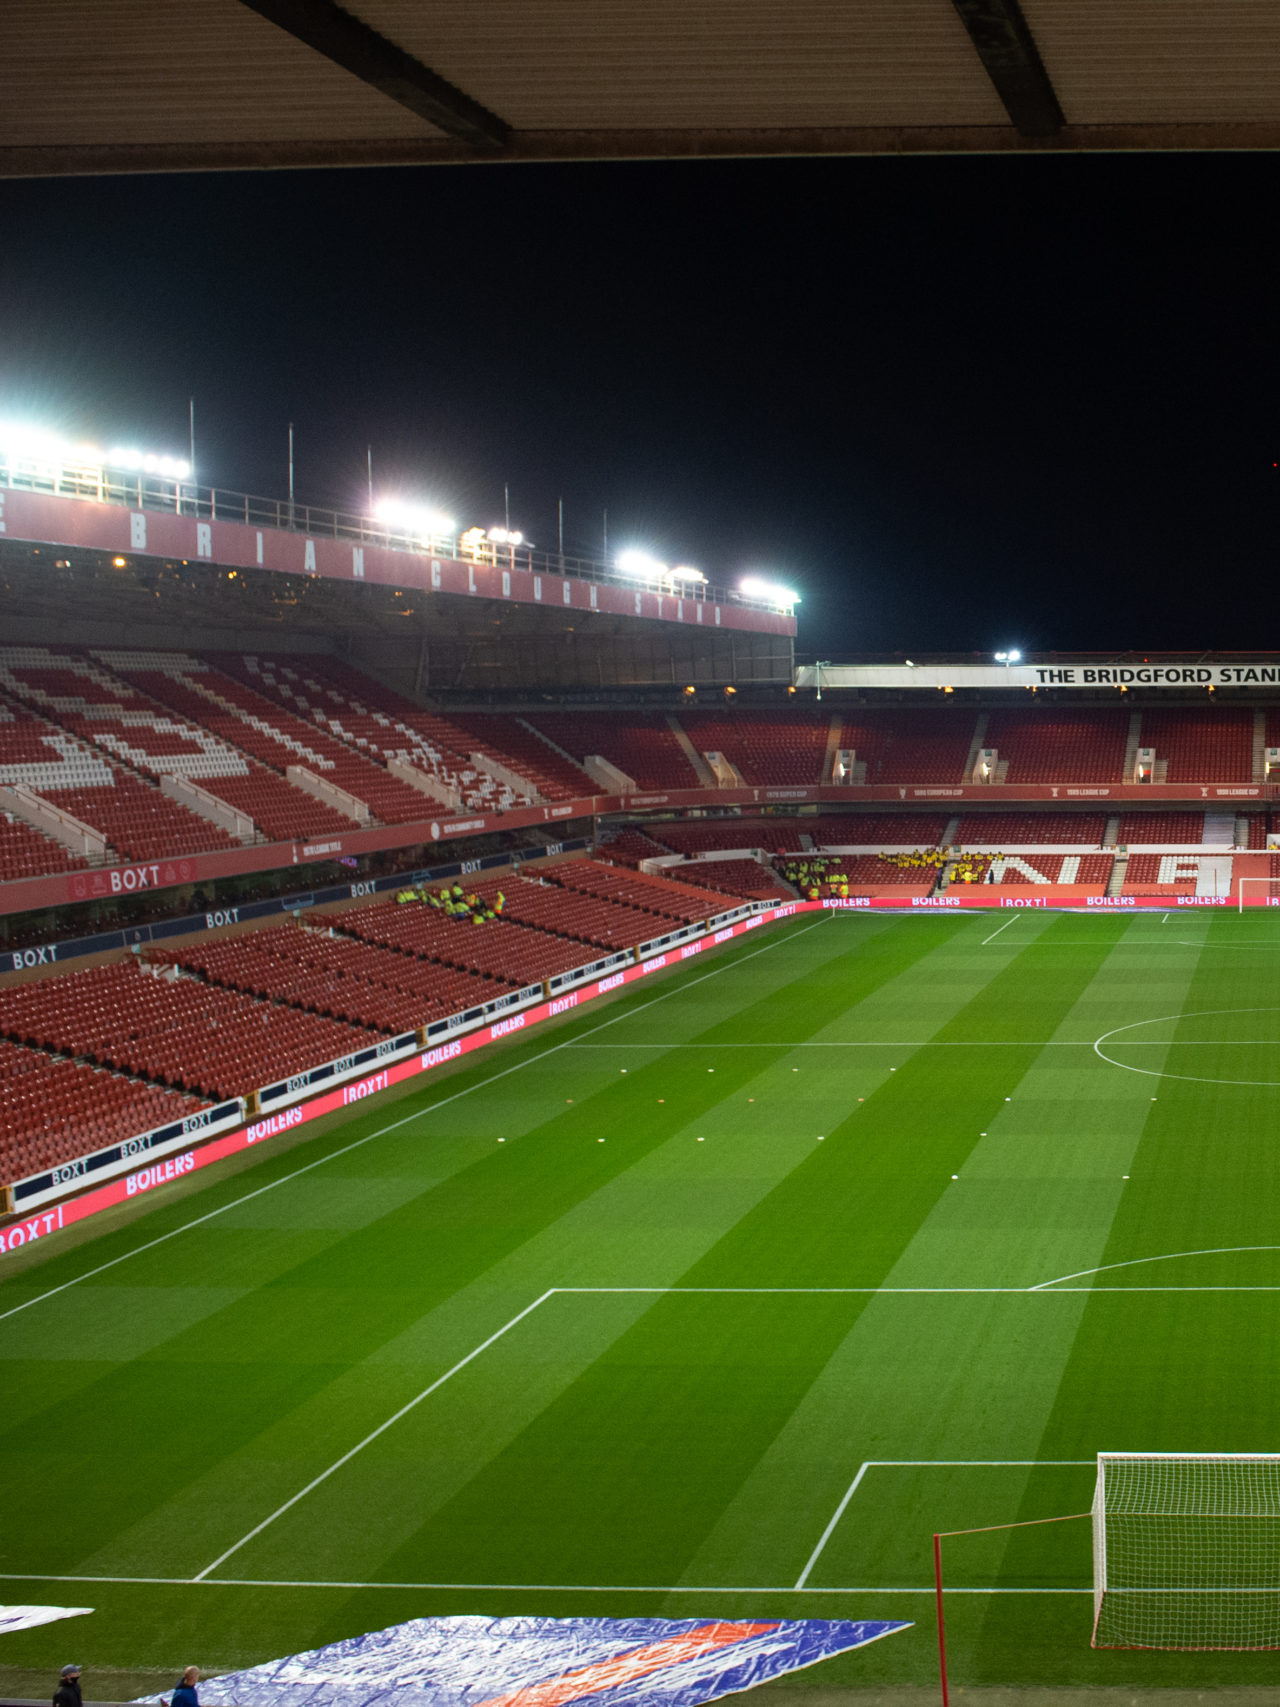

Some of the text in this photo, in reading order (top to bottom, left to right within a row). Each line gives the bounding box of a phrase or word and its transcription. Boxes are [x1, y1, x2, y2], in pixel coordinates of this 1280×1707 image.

[130, 512, 721, 626] BRIAN CLOUGH STAND
[1036, 669, 1075, 683] THE
[1083, 668, 1212, 683] BRIDGFORD
[111, 865, 160, 892] BOXT
[461, 859, 481, 874] BOXT
[351, 880, 376, 898] BOXT
[1087, 896, 1135, 905] BOILERS
[1177, 896, 1226, 905] BOILERS
[823, 898, 870, 908] BOILERS
[912, 897, 960, 906] BOILERS
[206, 908, 239, 929] BOXT
[12, 945, 57, 970] BOXT
[491, 1014, 525, 1039] BOILERS
[421, 1040, 461, 1068] BOILERS
[182, 1111, 212, 1134] BOXT
[247, 1106, 303, 1143] BOILERS
[121, 1134, 153, 1159] BOXT
[52, 1159, 88, 1186] BOXT
[126, 1151, 195, 1195] BOILERS
